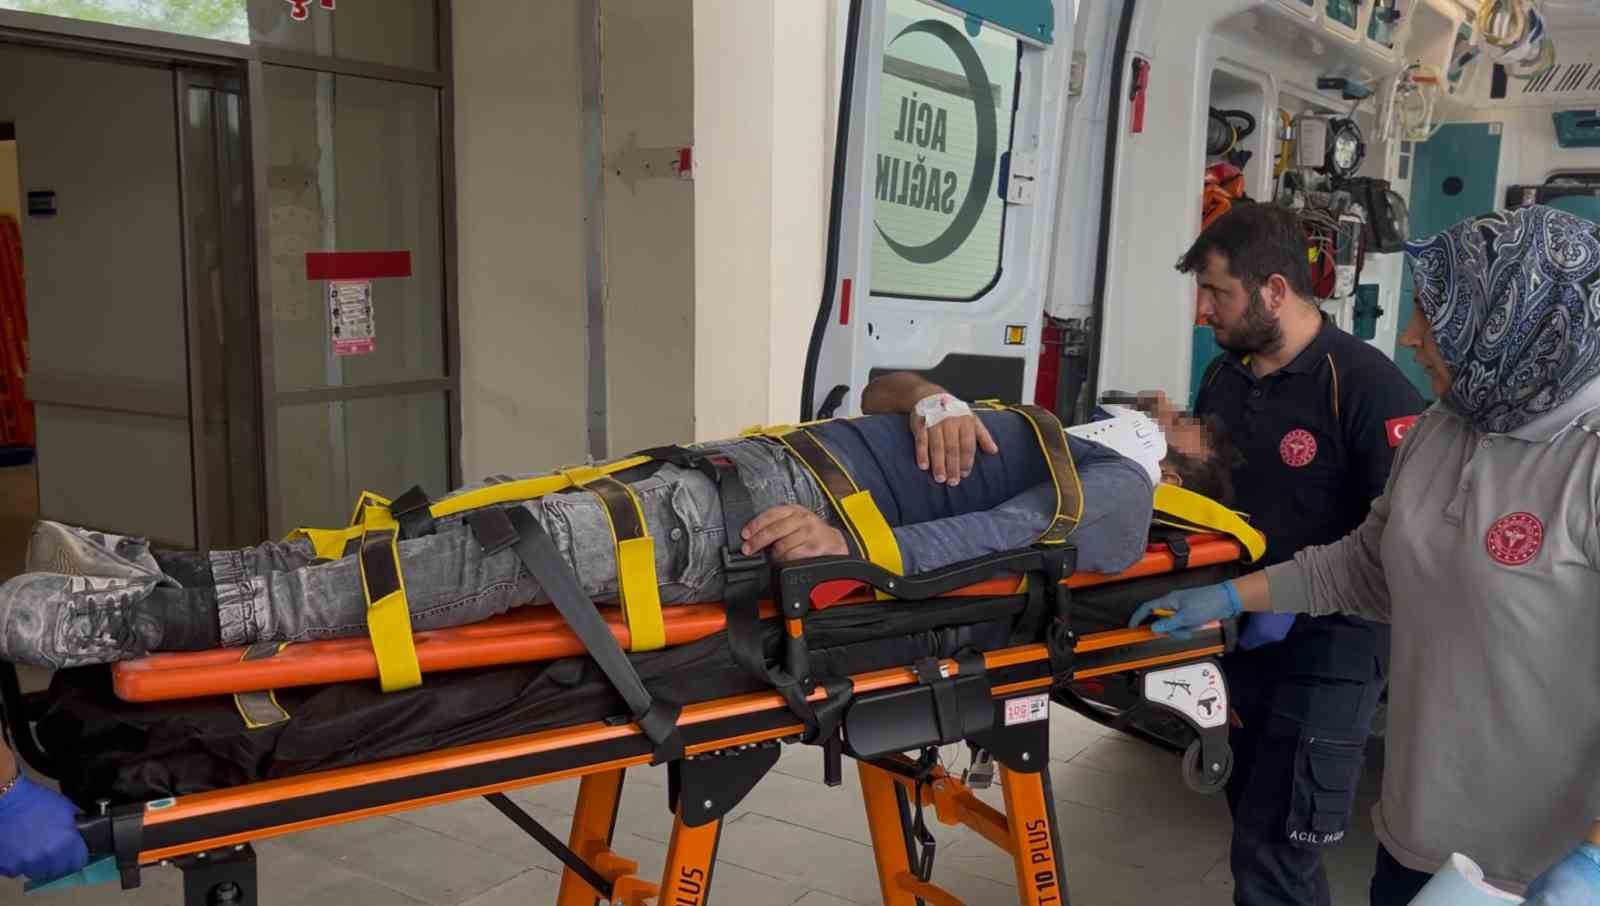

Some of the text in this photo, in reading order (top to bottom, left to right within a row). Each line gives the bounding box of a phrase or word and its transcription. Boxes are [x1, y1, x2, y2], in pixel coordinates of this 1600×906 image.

[1025, 819, 1051, 864] PLUS
[675, 865, 704, 906] LUS
[1033, 870, 1056, 892] 10
